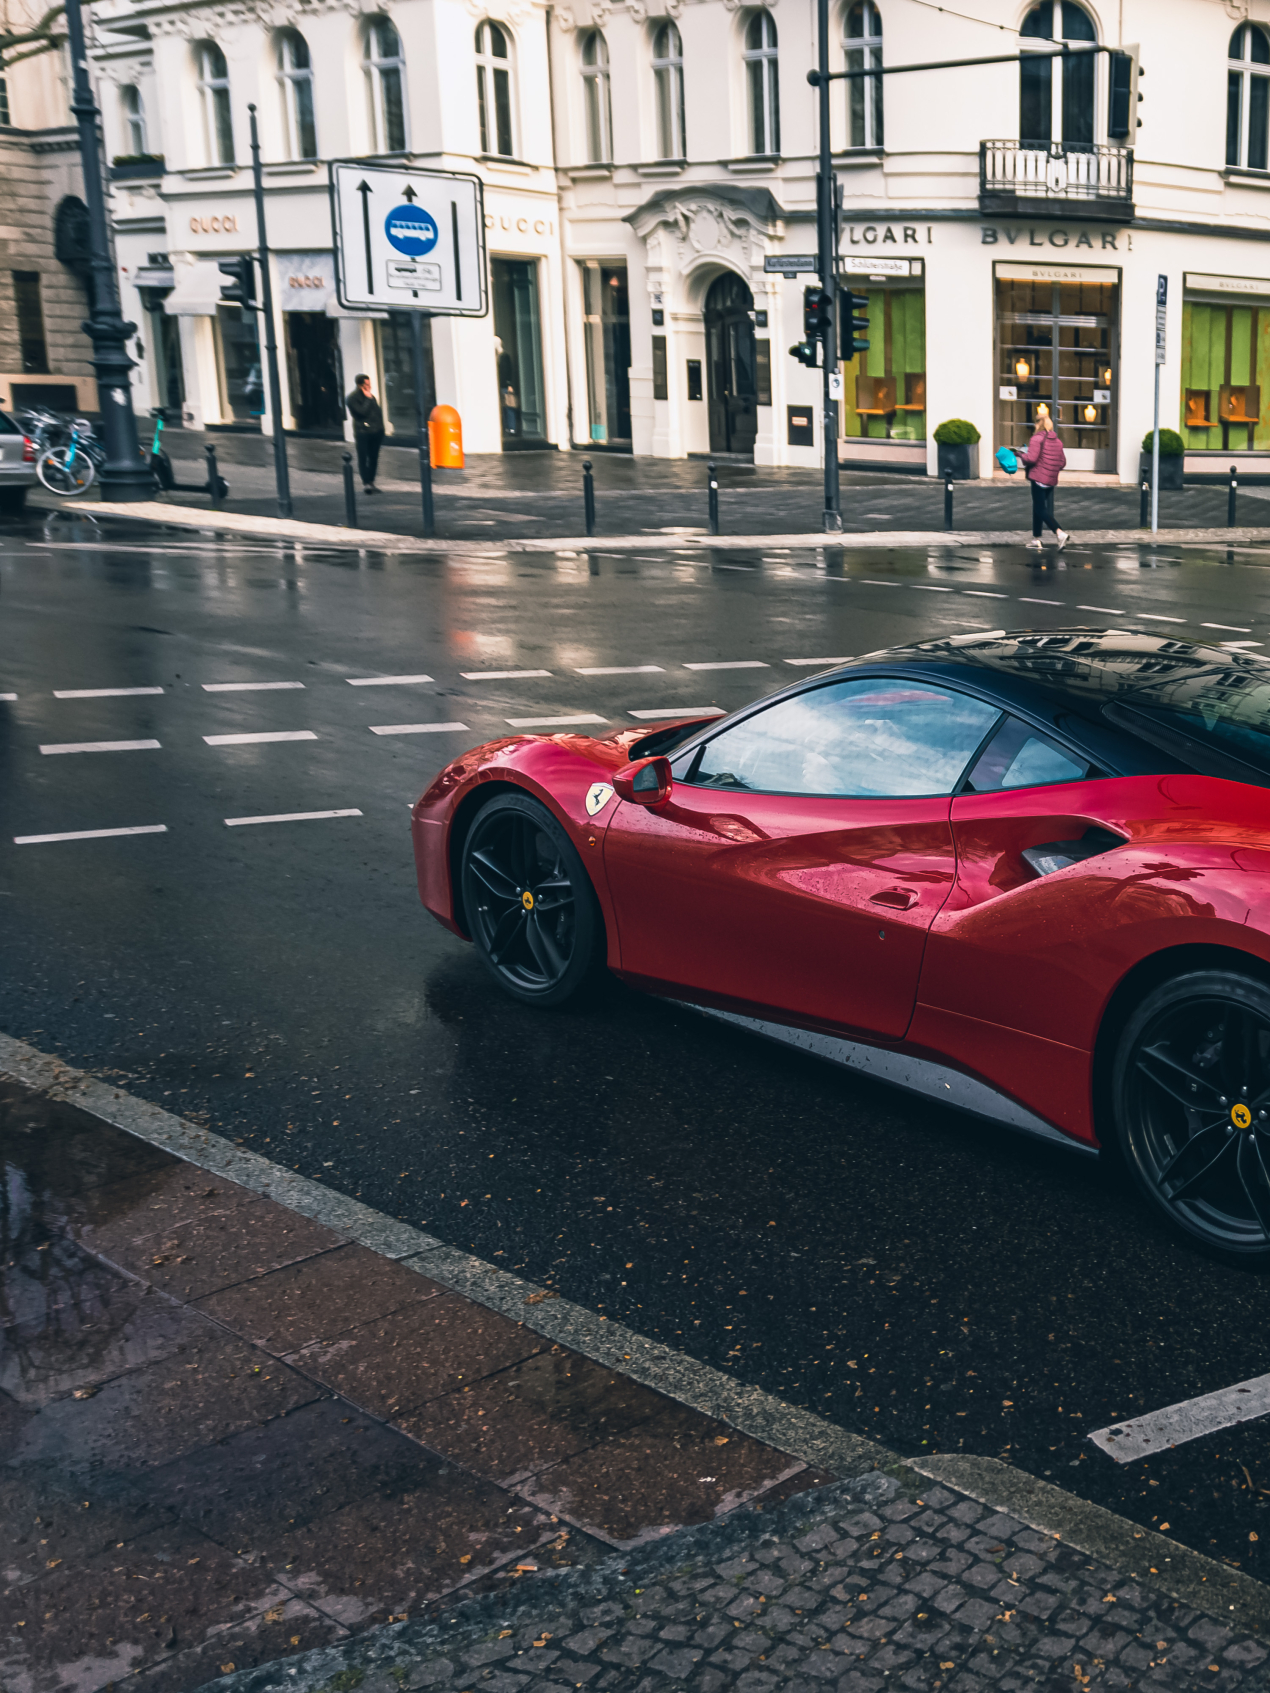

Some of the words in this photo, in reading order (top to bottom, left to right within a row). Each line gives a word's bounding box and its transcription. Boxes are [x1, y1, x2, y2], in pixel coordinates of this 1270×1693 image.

[190, 214, 239, 235] GUCCI
[484, 213, 554, 235] GUCCI
[980, 226, 1134, 252] BVLGARI
[289, 275, 325, 289] GUCCI
[1031, 269, 1083, 280] BVLGARI
